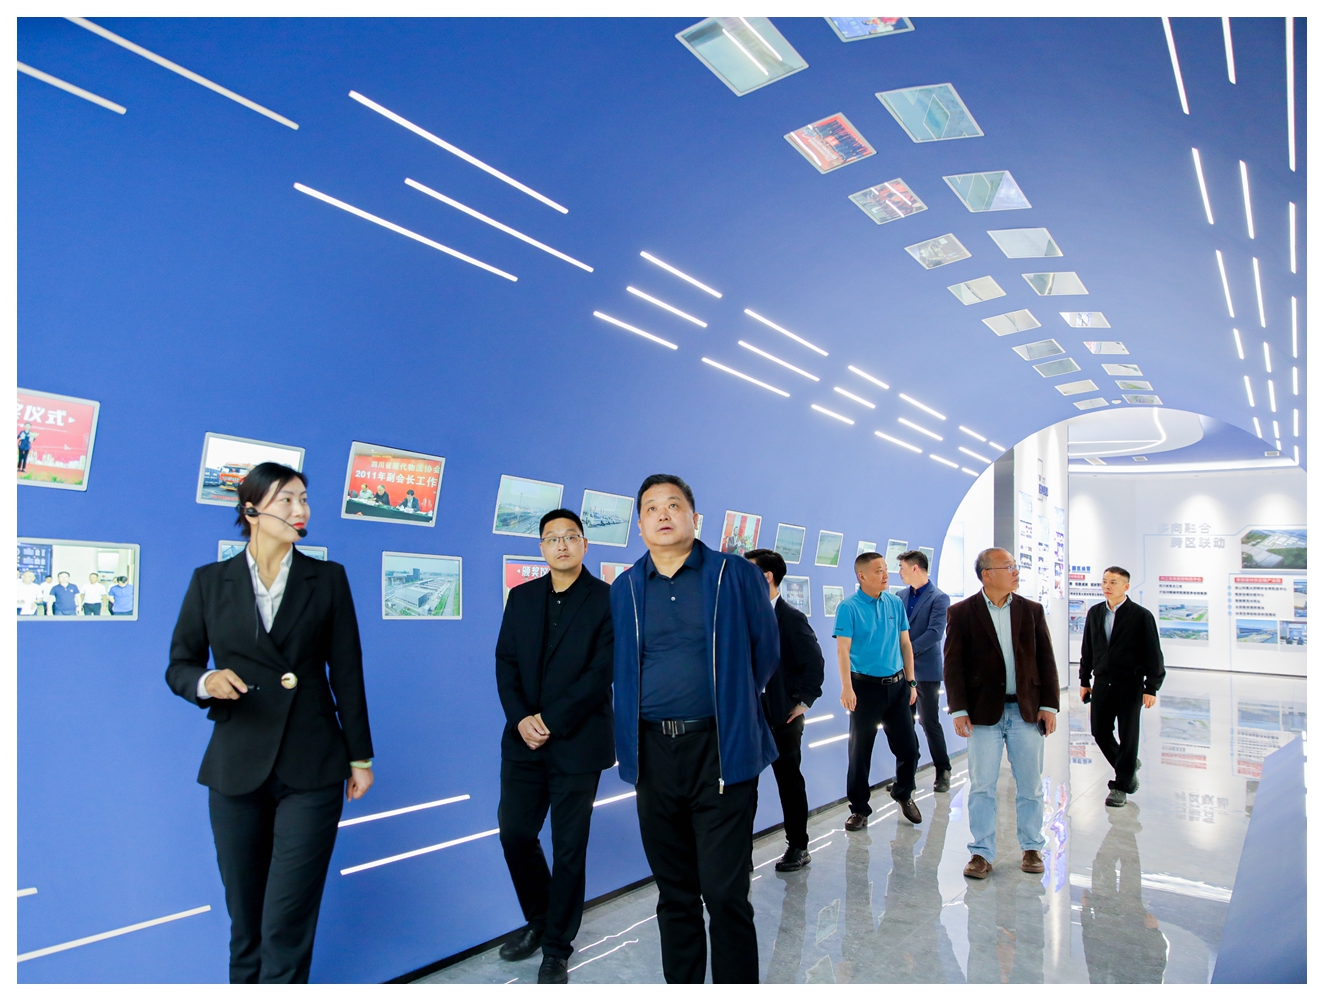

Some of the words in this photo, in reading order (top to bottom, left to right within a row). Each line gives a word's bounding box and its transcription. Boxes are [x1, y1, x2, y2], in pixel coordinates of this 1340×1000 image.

[355, 469, 438, 488] 2011年副会长工作
[1170, 537, 1226, 549] 跨区联动
